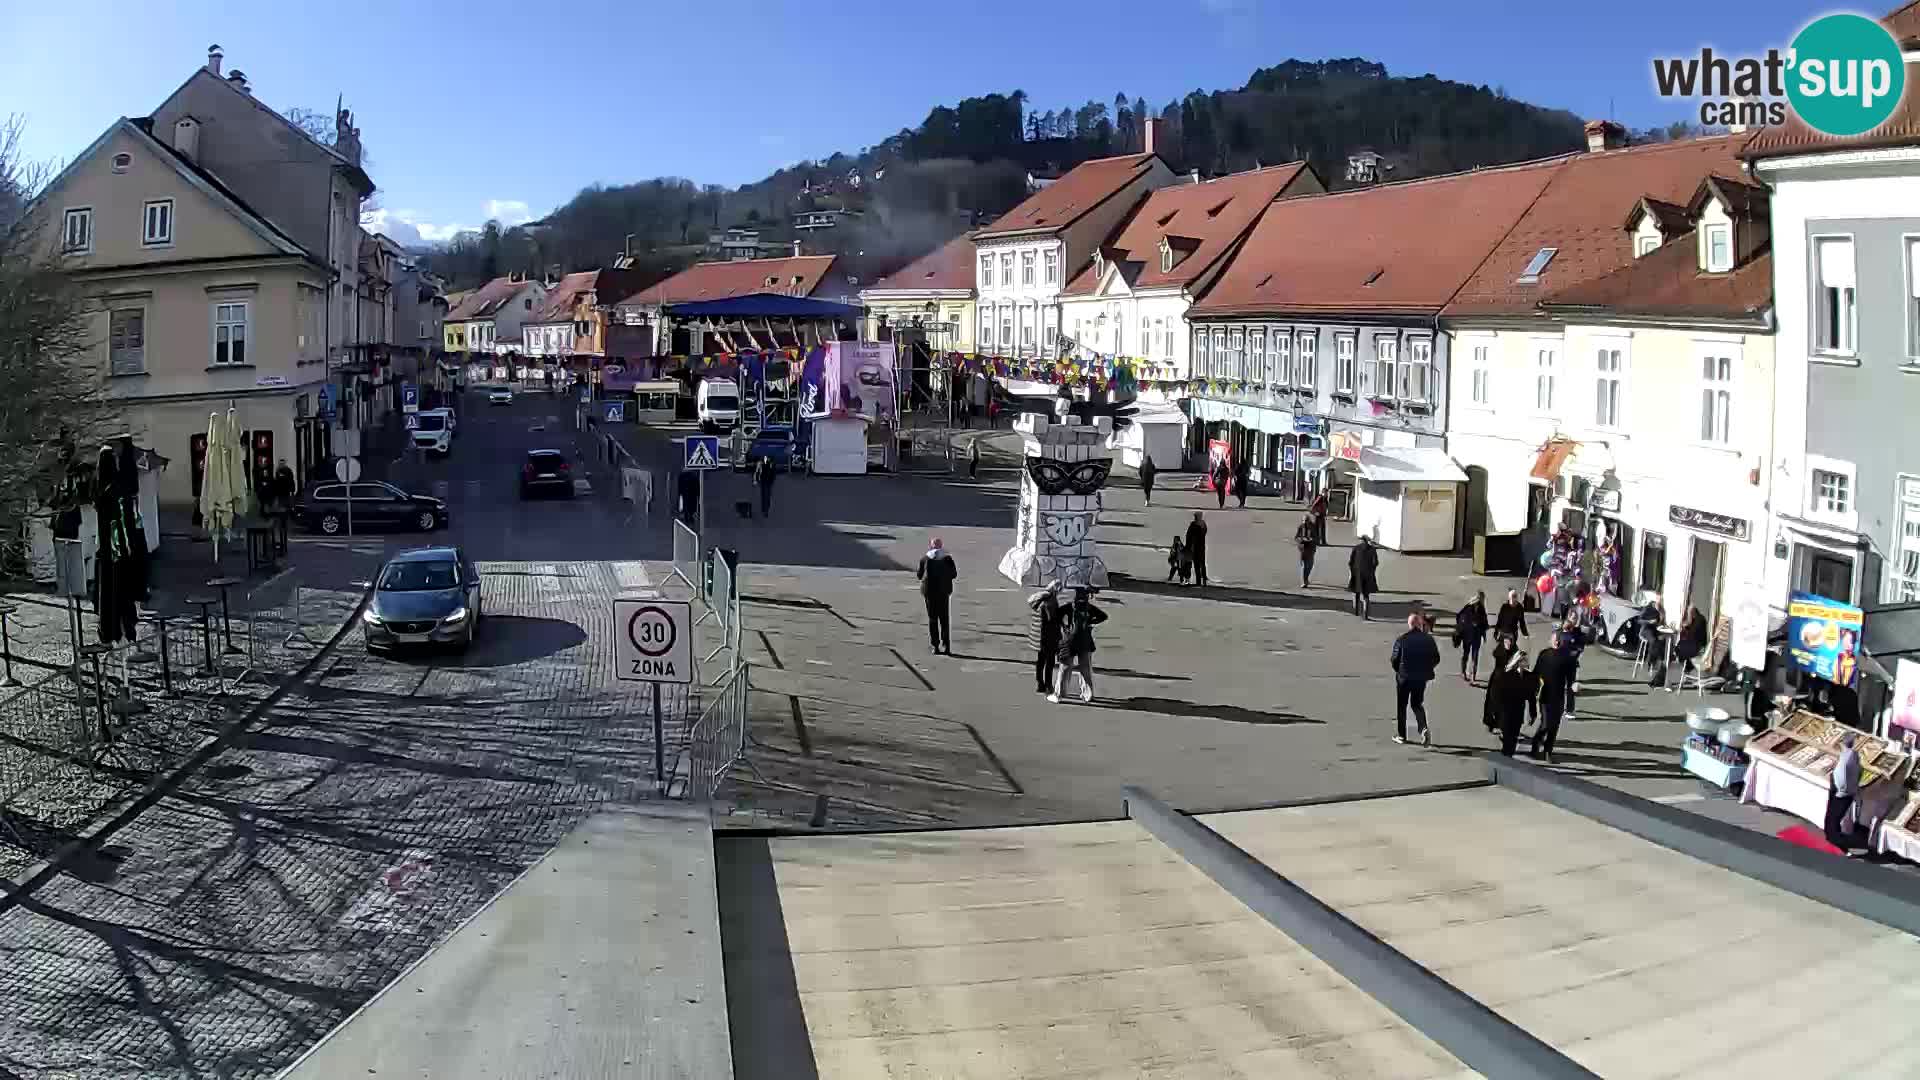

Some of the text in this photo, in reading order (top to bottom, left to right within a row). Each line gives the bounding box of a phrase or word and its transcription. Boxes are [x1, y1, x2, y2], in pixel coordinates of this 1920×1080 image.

[406, 391, 415, 401] P
[641, 622, 665, 643] 30
[631, 660, 675, 676] ZONA
